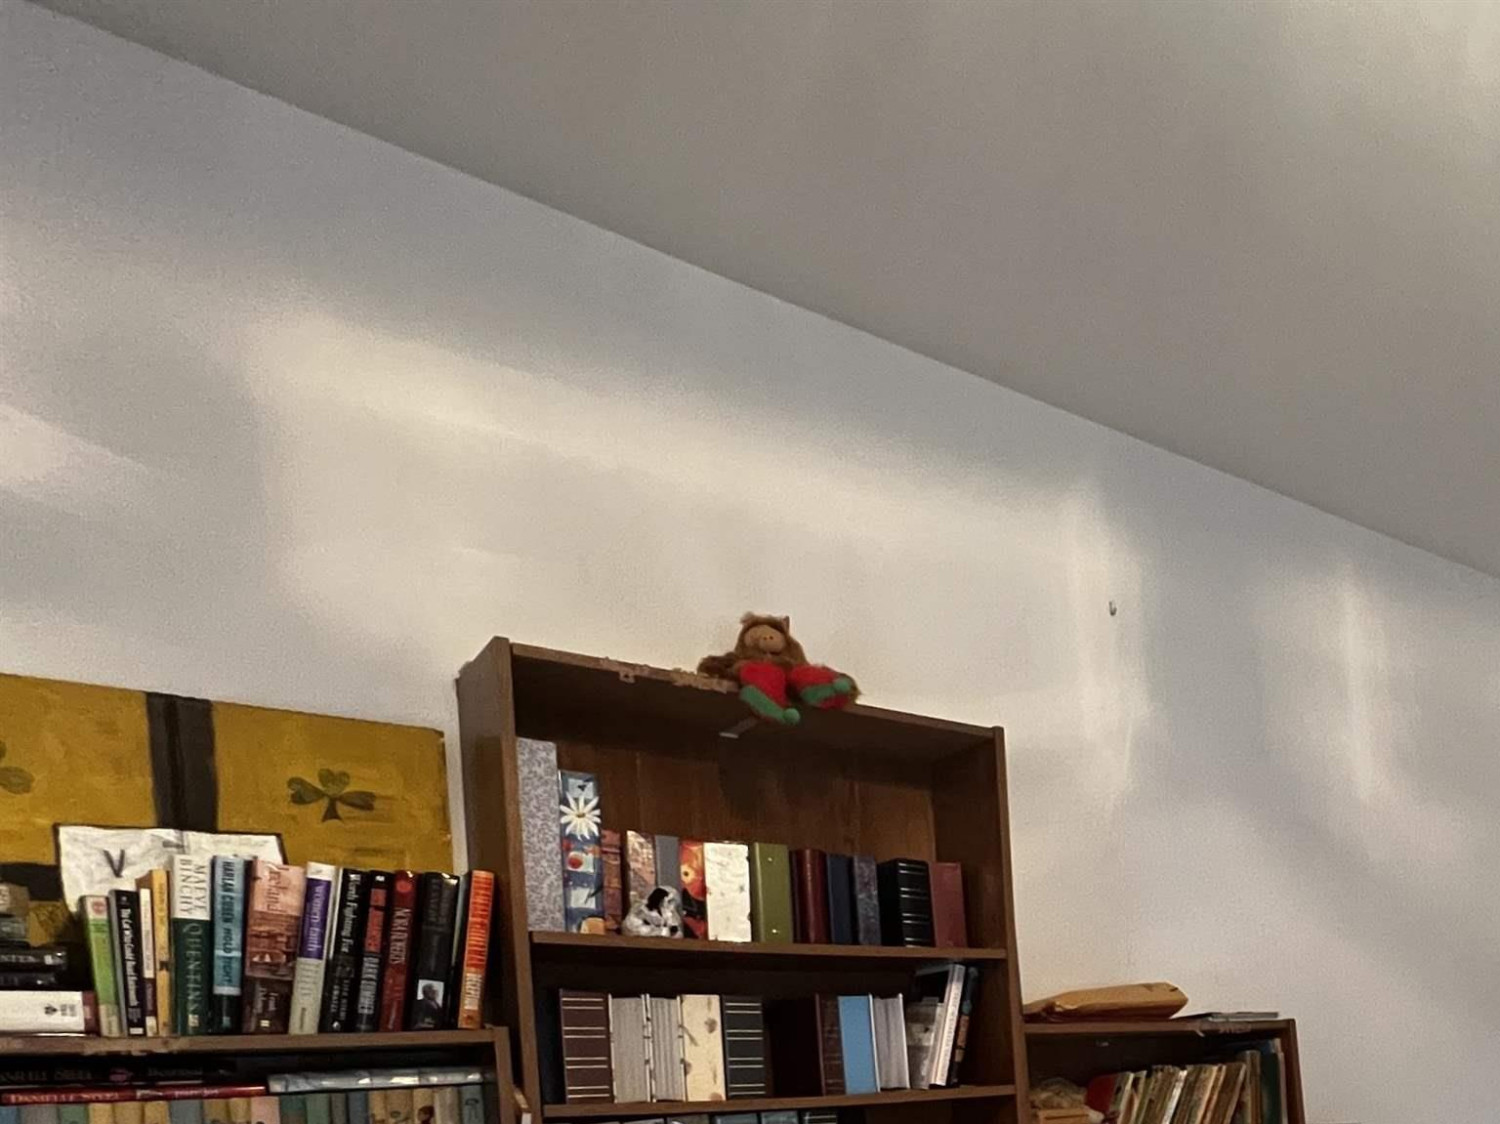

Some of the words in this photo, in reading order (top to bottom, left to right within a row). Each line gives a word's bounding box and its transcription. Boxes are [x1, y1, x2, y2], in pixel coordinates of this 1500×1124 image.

[179, 858, 194, 914] BINCHY
[192, 864, 208, 911] MAEVE
[221, 861, 236, 893] HARLAN
[341, 902, 358, 938] Fighting
[222, 928, 234, 954] HOLD
[183, 923, 203, 1016] QUENTINS
[362, 957, 379, 979] DARK
